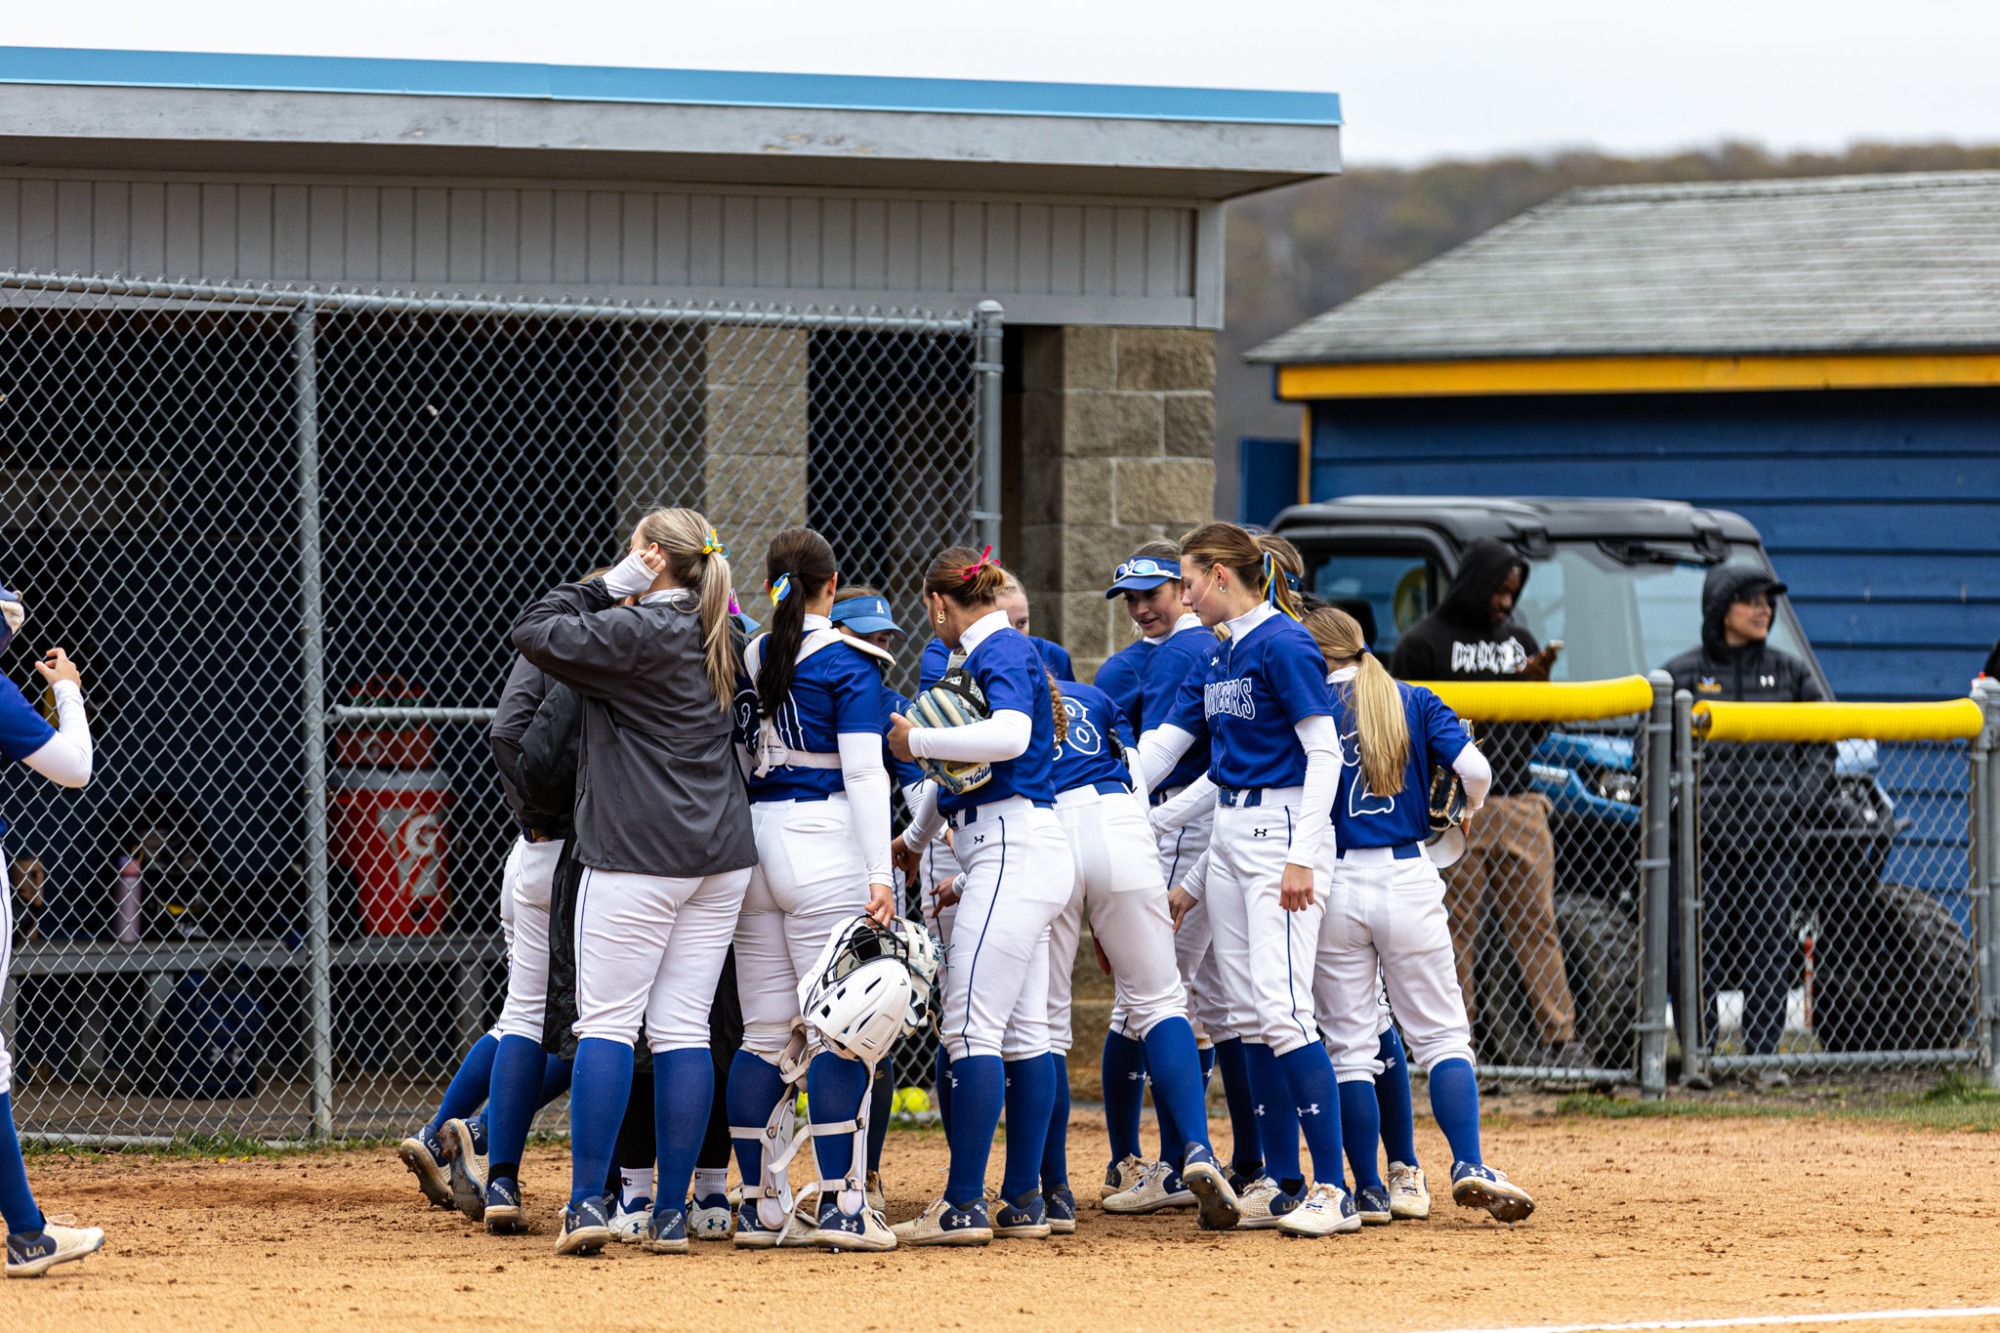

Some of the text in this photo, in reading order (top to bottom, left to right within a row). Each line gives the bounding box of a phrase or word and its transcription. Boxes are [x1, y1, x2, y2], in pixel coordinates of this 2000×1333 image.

[876, 600, 885, 614] A
[469, 1122, 481, 1141] UA
[427, 1138, 441, 1157] UA
[1011, 1213, 1032, 1224] UA
[25, 1245, 47, 1258] UA
